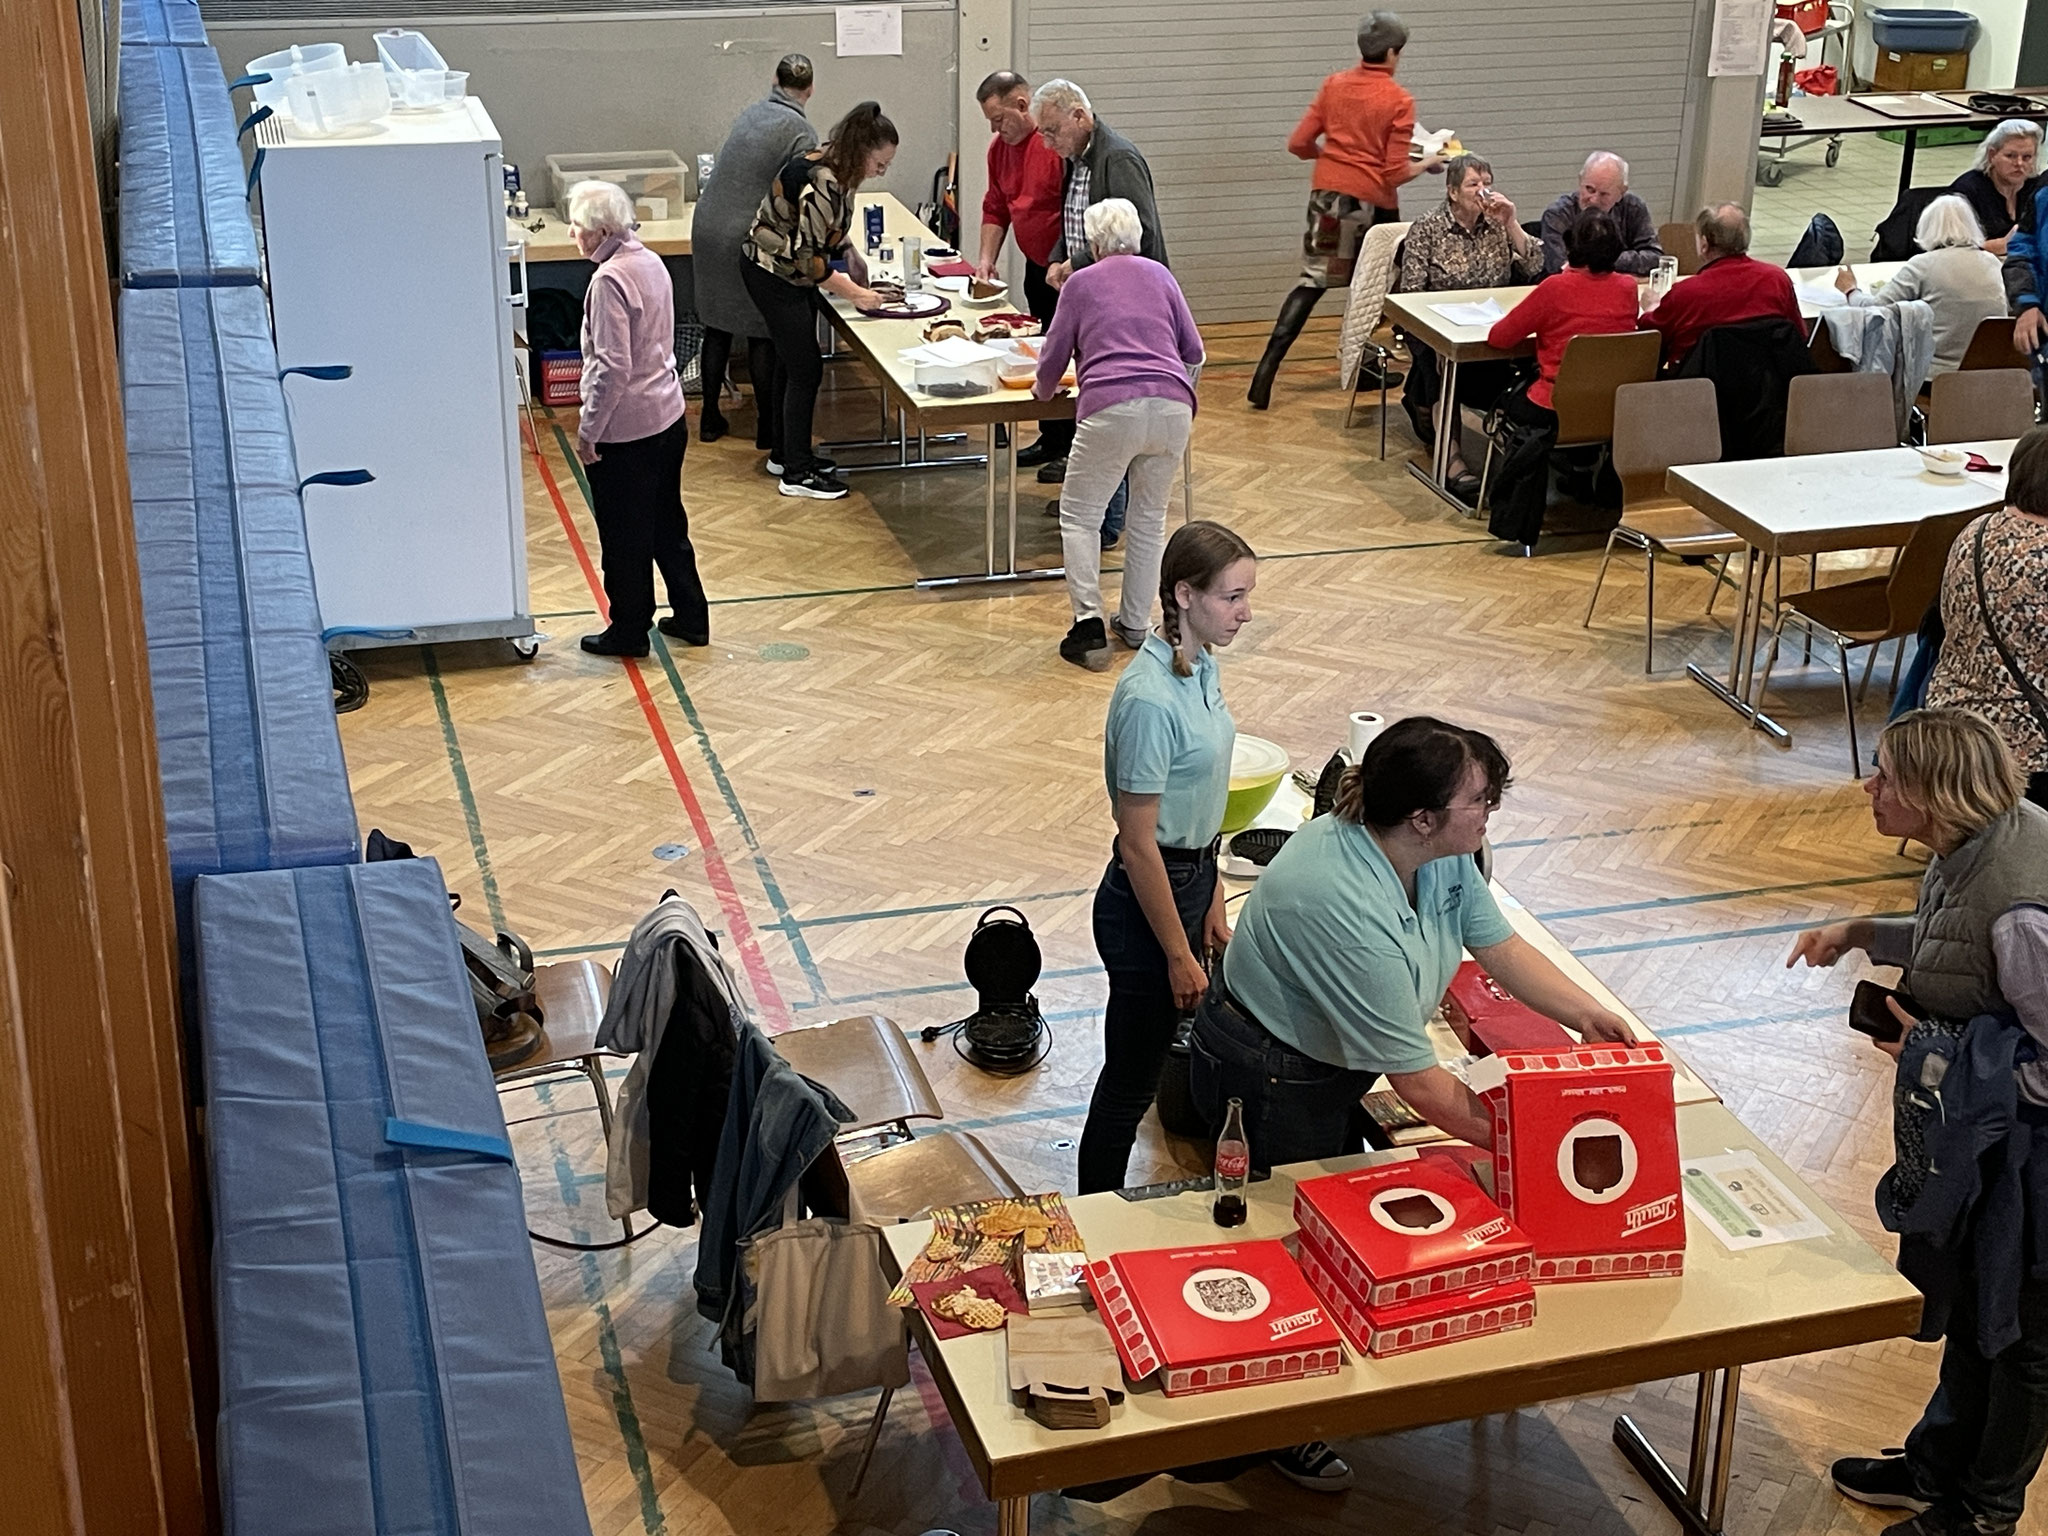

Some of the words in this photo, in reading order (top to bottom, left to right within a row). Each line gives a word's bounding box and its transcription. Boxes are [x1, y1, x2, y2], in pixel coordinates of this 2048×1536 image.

[1462, 1216, 1511, 1250] Trauth
[1621, 1194, 1678, 1238] Trauth
[1269, 1307, 1323, 1341] Trauth
